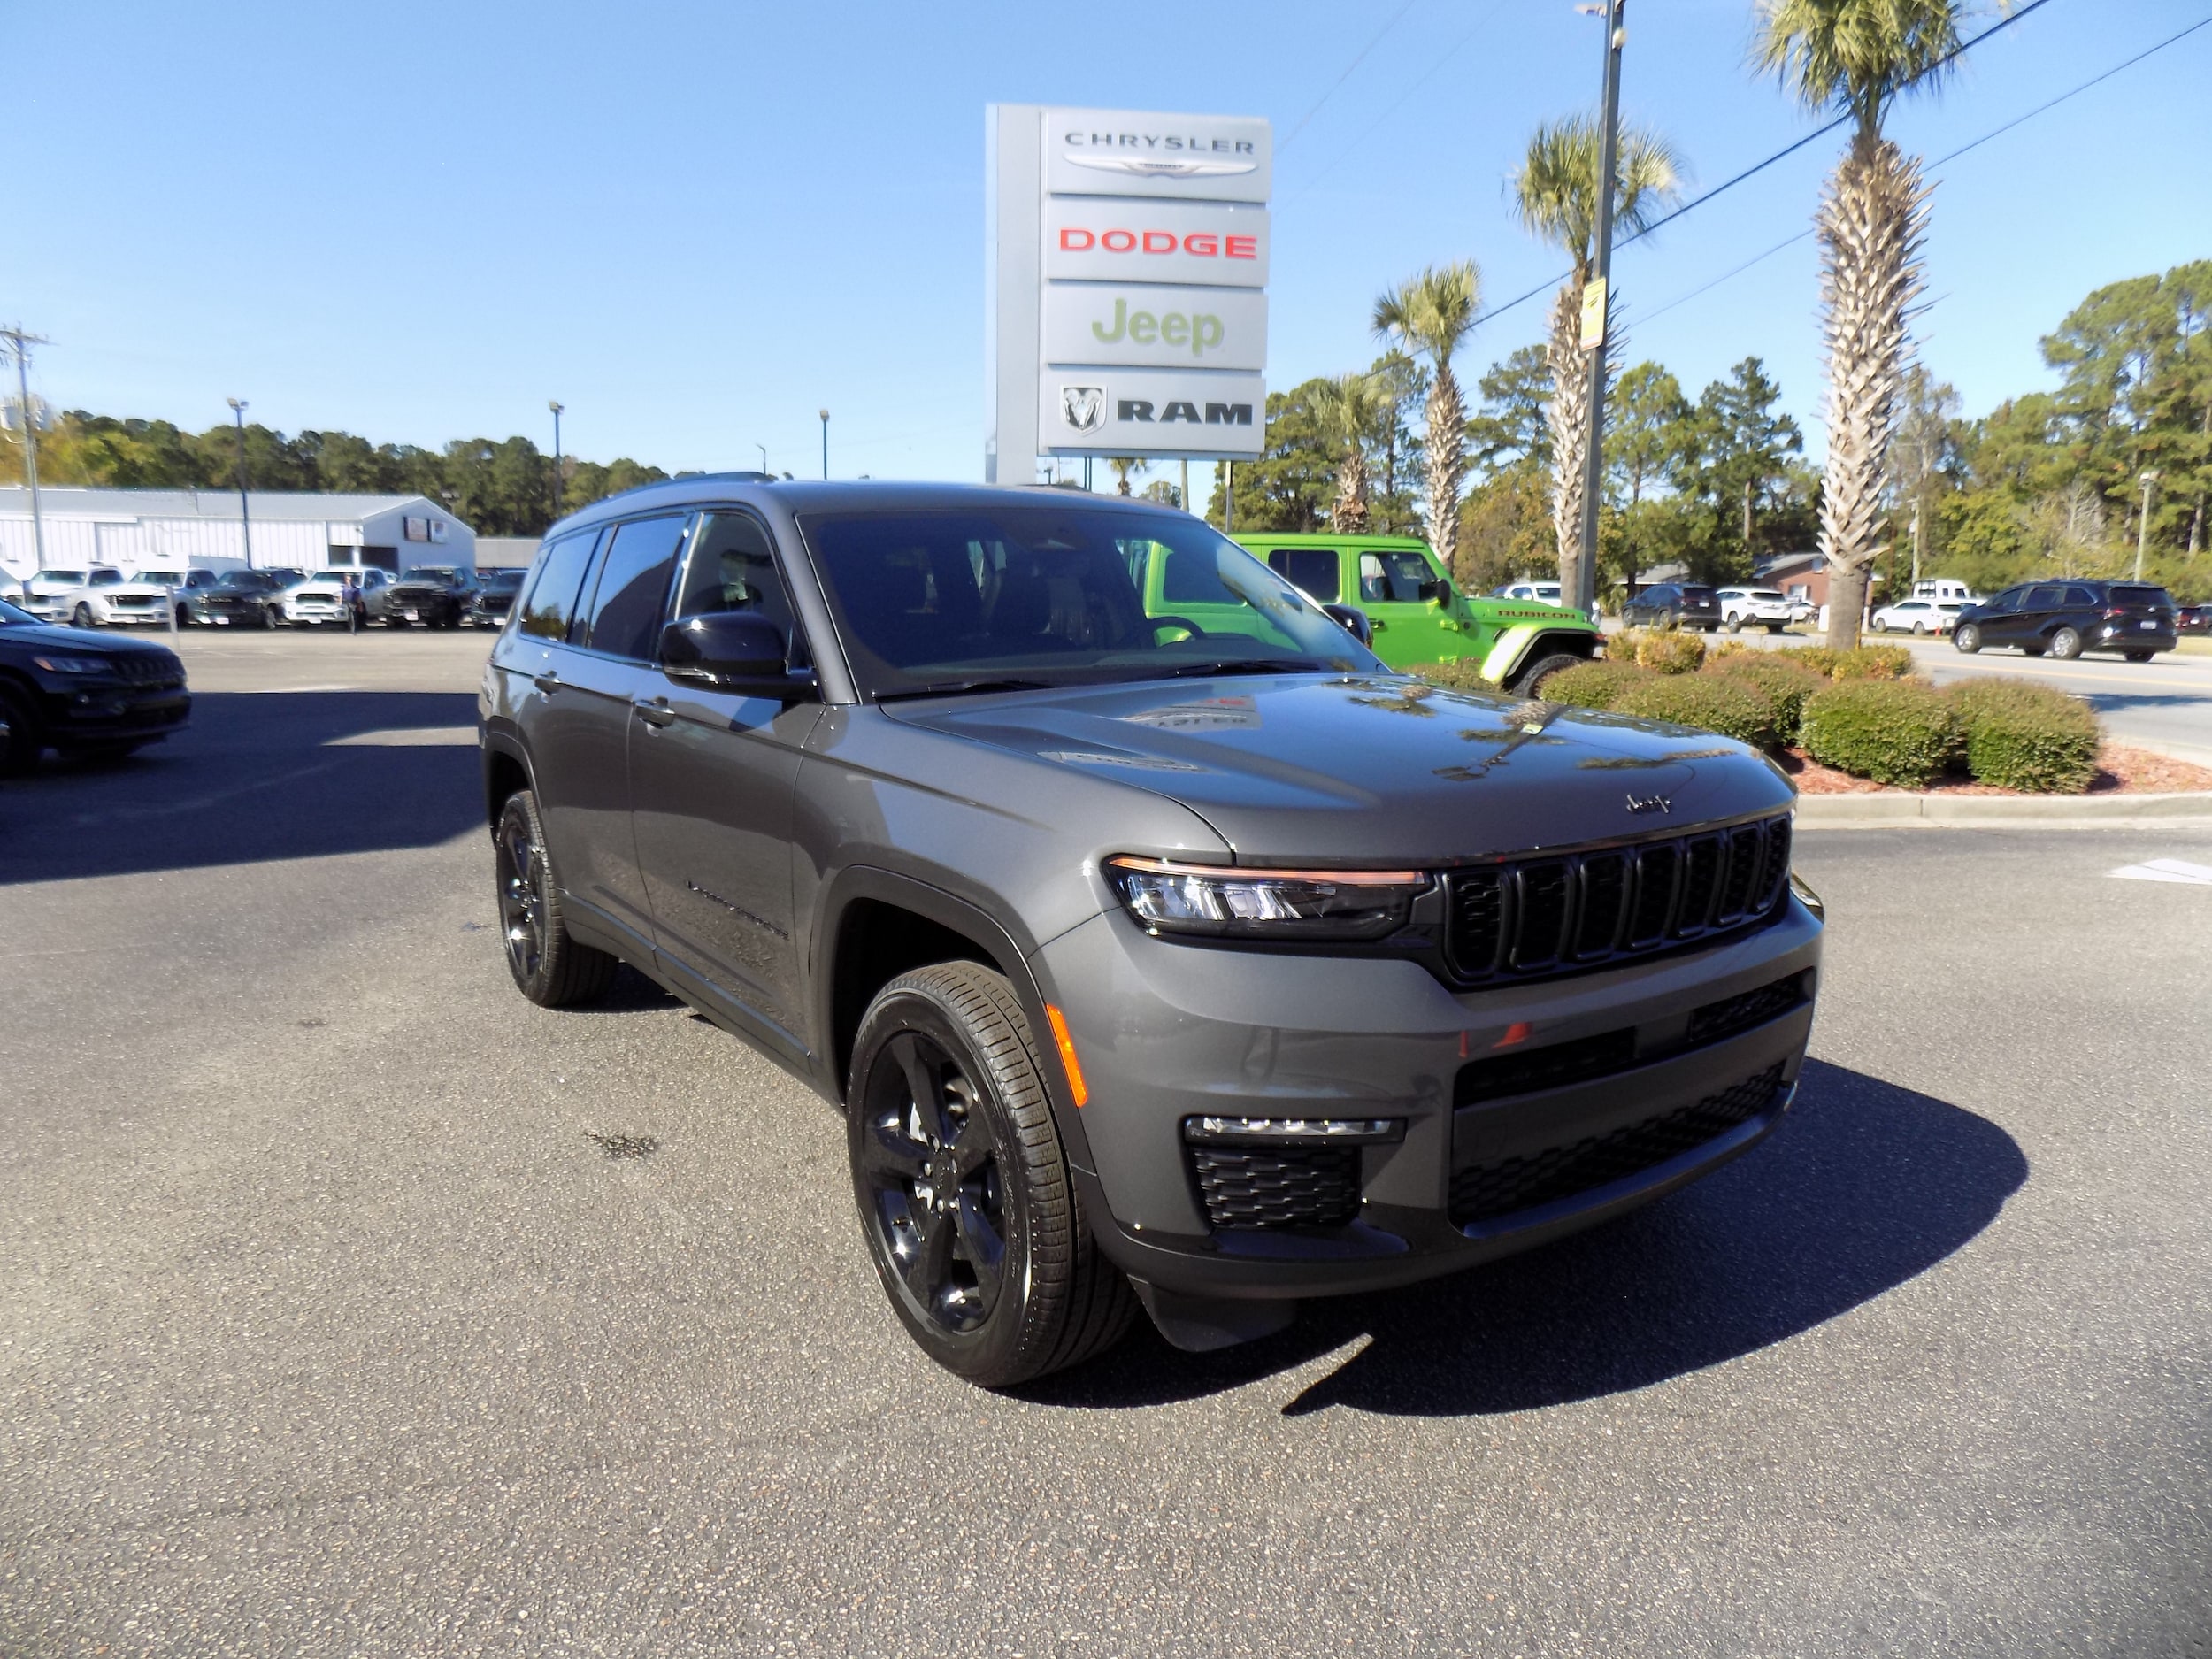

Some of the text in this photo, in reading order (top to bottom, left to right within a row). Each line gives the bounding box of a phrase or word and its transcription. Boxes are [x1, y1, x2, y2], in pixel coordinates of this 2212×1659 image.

[1065, 133, 1255, 155] CHRYSLER
[1060, 229, 1256, 259] DODGE
[1093, 298, 1224, 357] Jeep
[1117, 399, 1253, 426] RAM
